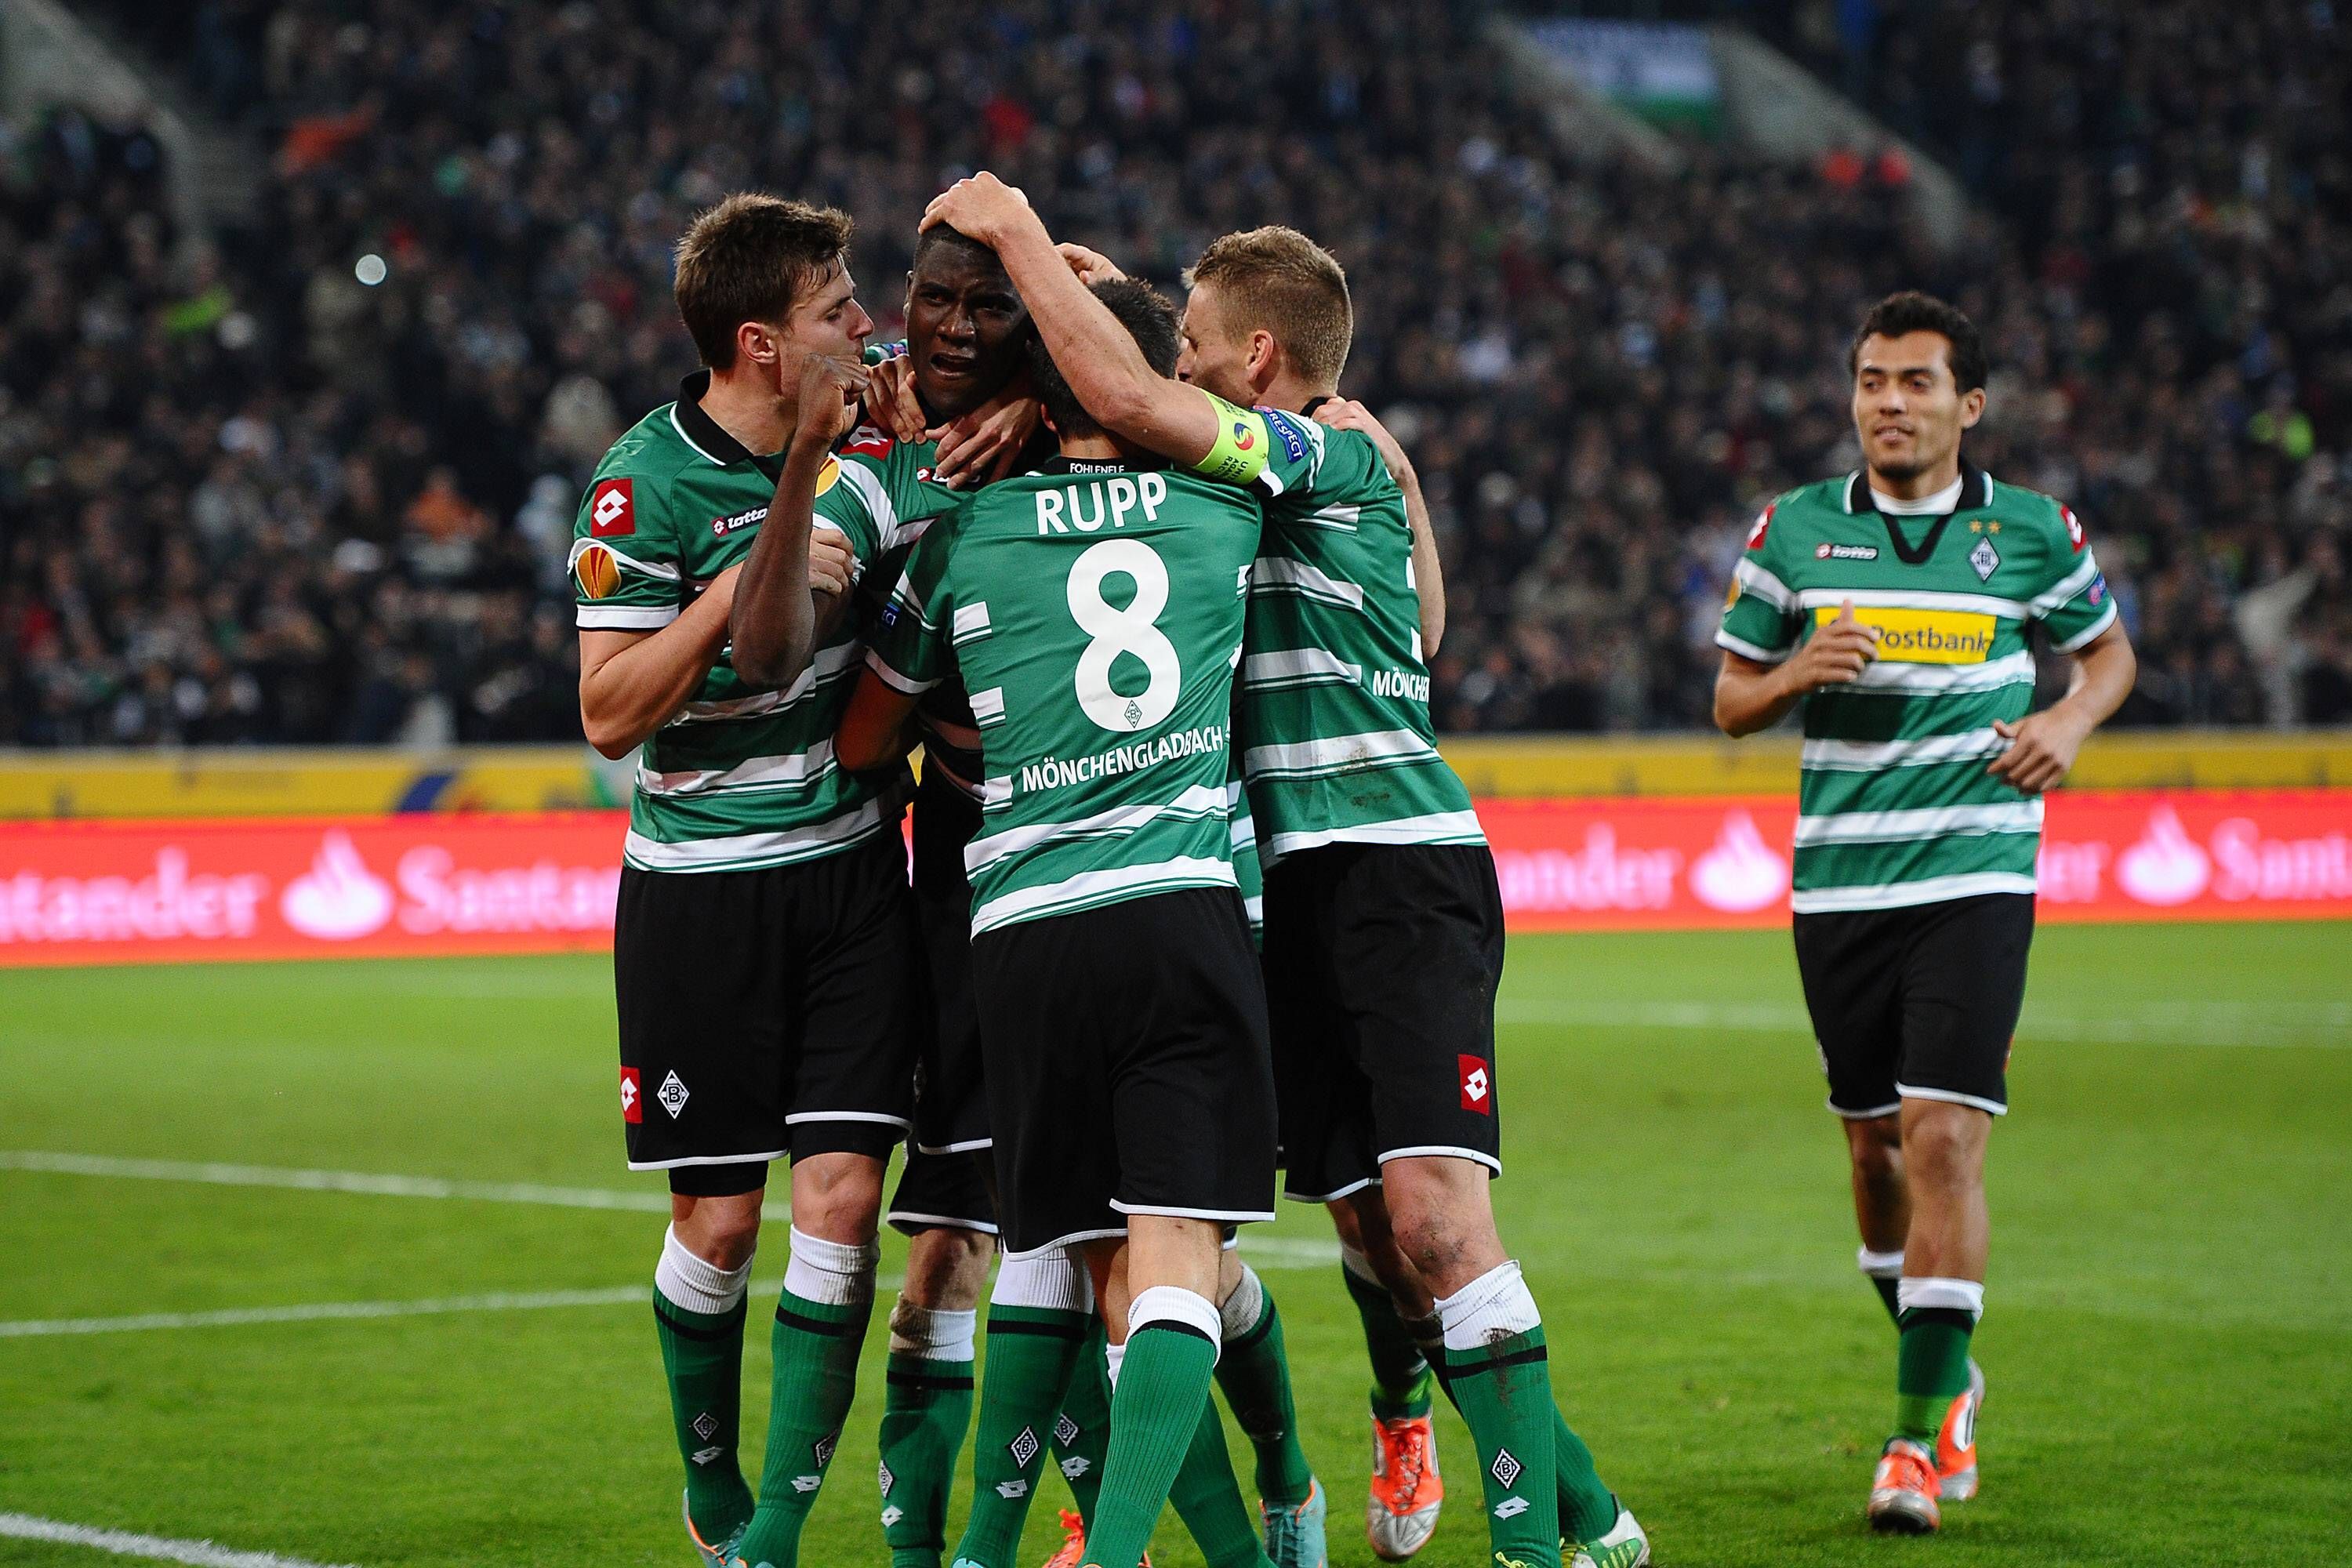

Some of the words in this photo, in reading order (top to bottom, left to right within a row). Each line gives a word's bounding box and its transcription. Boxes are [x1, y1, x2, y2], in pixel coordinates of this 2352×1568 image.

[1269, 412, 1303, 457] RESPECT
[1035, 472, 1167, 535] RUPP
[1065, 538, 1181, 732] 8
[1022, 725, 1223, 793] MÖNCHENGLADBACH
